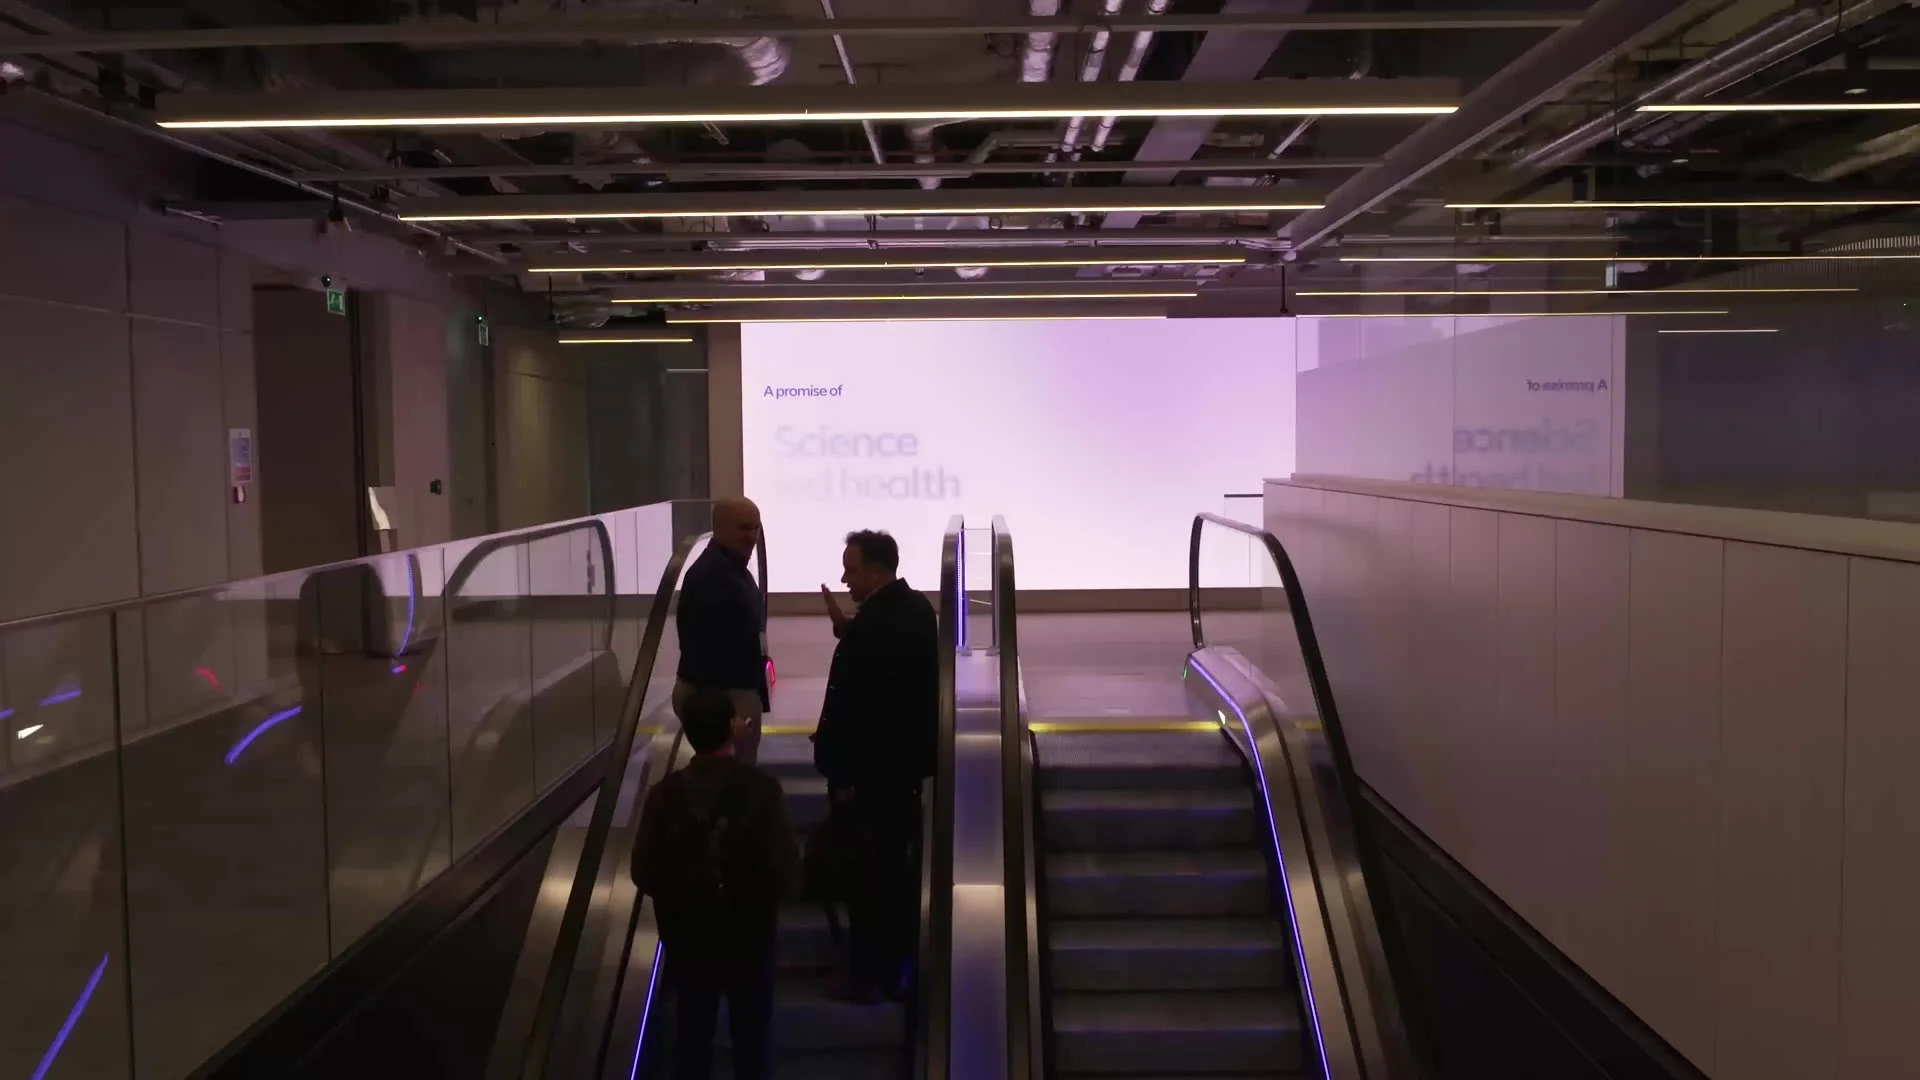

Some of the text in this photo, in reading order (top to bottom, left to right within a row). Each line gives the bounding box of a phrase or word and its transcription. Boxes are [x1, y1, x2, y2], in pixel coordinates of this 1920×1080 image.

[763, 384, 844, 399] A promise of
[774, 424, 919, 457] Science
